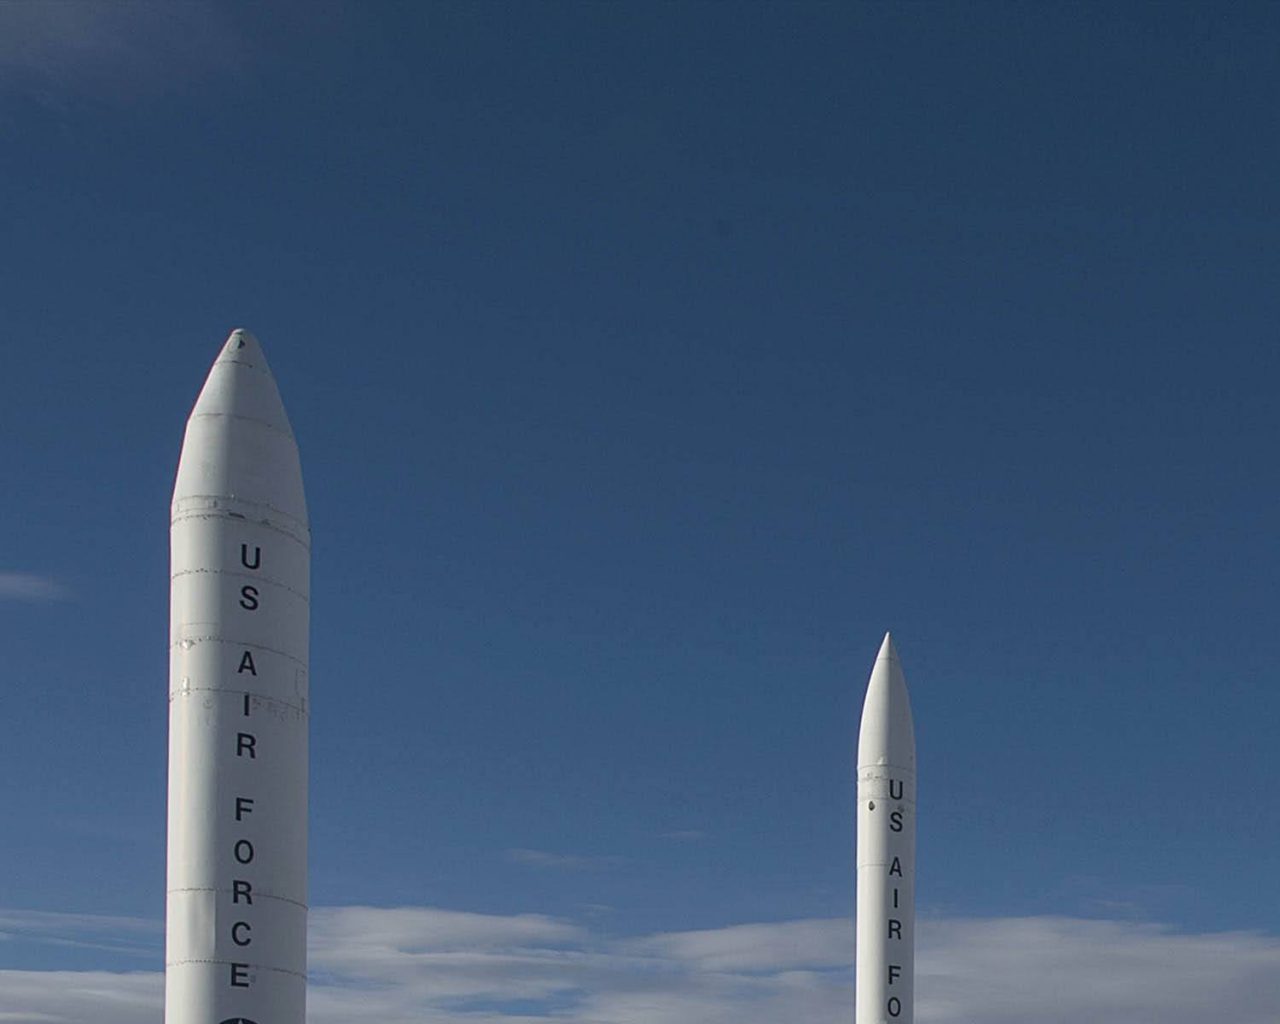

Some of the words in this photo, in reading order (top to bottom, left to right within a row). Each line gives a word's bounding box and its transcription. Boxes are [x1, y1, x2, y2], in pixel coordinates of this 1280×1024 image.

[239, 543, 261, 611] US
[236, 650, 257, 759] AIR
[889, 779, 903, 833] US
[230, 797, 255, 988] FORCE
[888, 856, 903, 940] AIR
